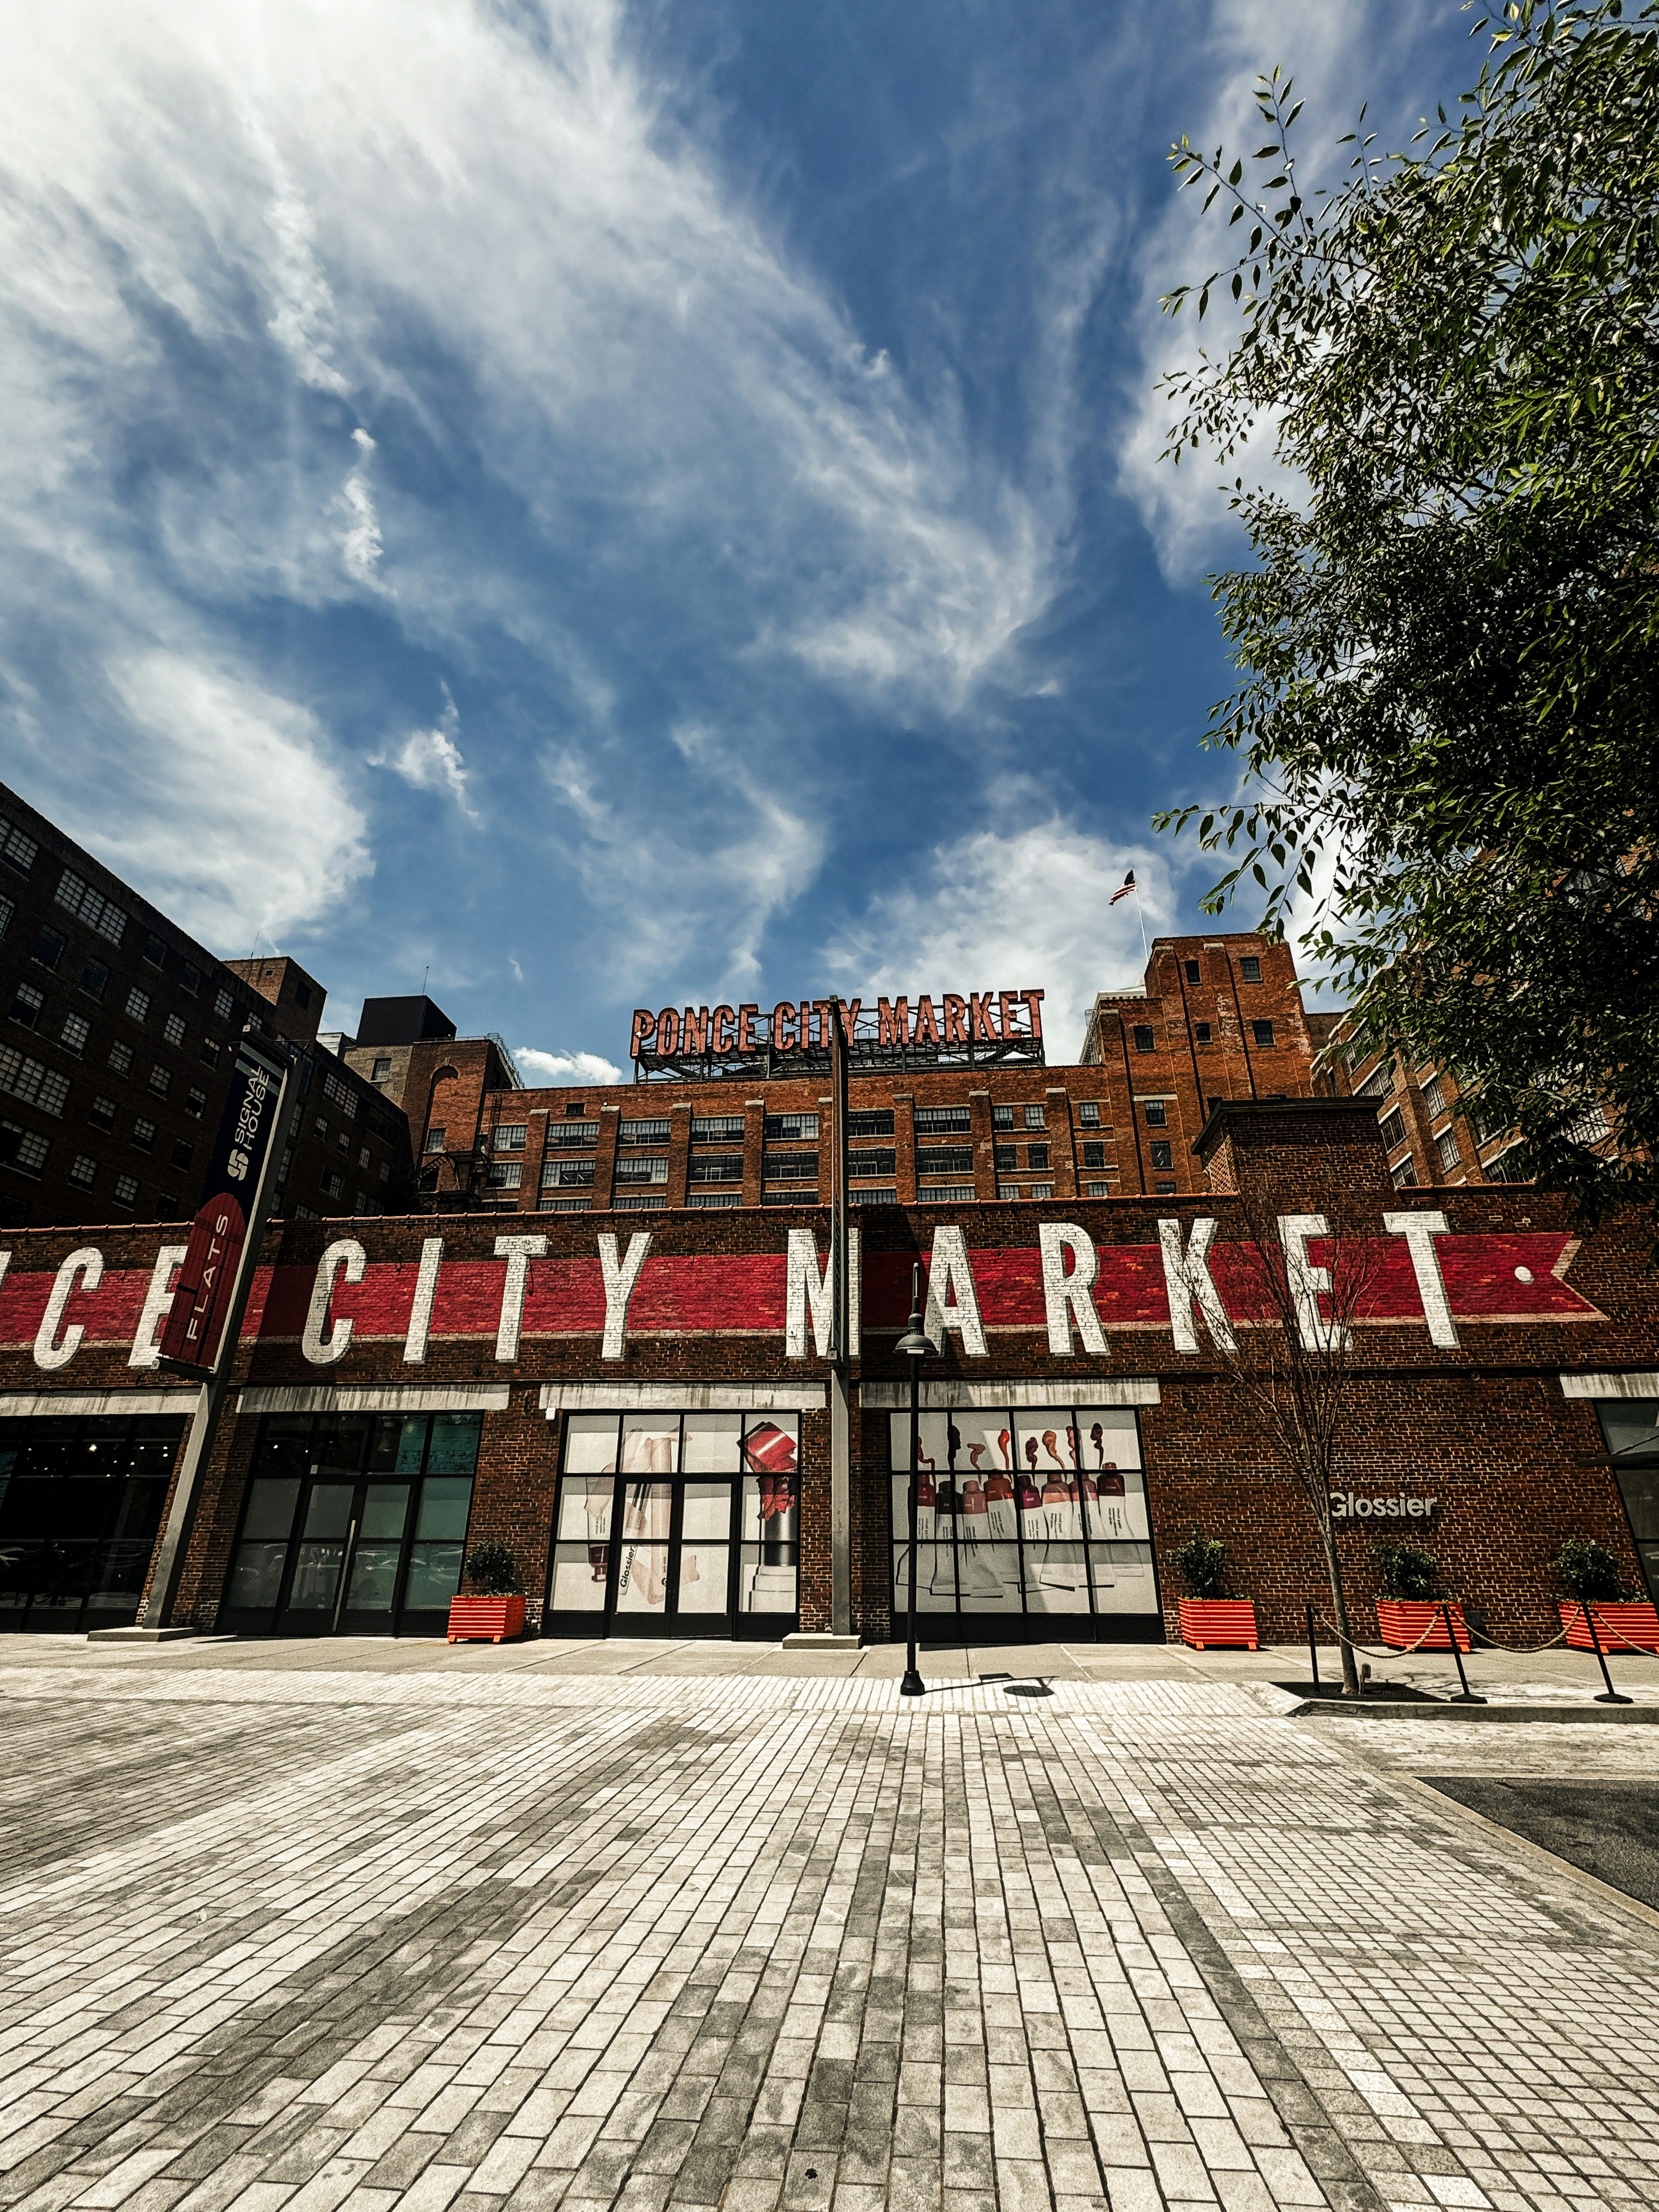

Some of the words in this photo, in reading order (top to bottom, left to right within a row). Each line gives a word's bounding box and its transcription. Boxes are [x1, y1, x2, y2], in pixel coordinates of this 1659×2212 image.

[630, 1003, 759, 1060] PONCE
[773, 997, 862, 1052] CITY
[877, 989, 1045, 1049] MARKET
[234, 1066, 262, 1144] SIGNAL
[243, 1073, 269, 1150] HOUSE
[0, 1246, 189, 1369] CE
[302, 1232, 655, 1364] CITY
[785, 1211, 1461, 1359] MARKET
[186, 1213, 228, 1341] FLATS
[1329, 1491, 1437, 1517] Glossier
